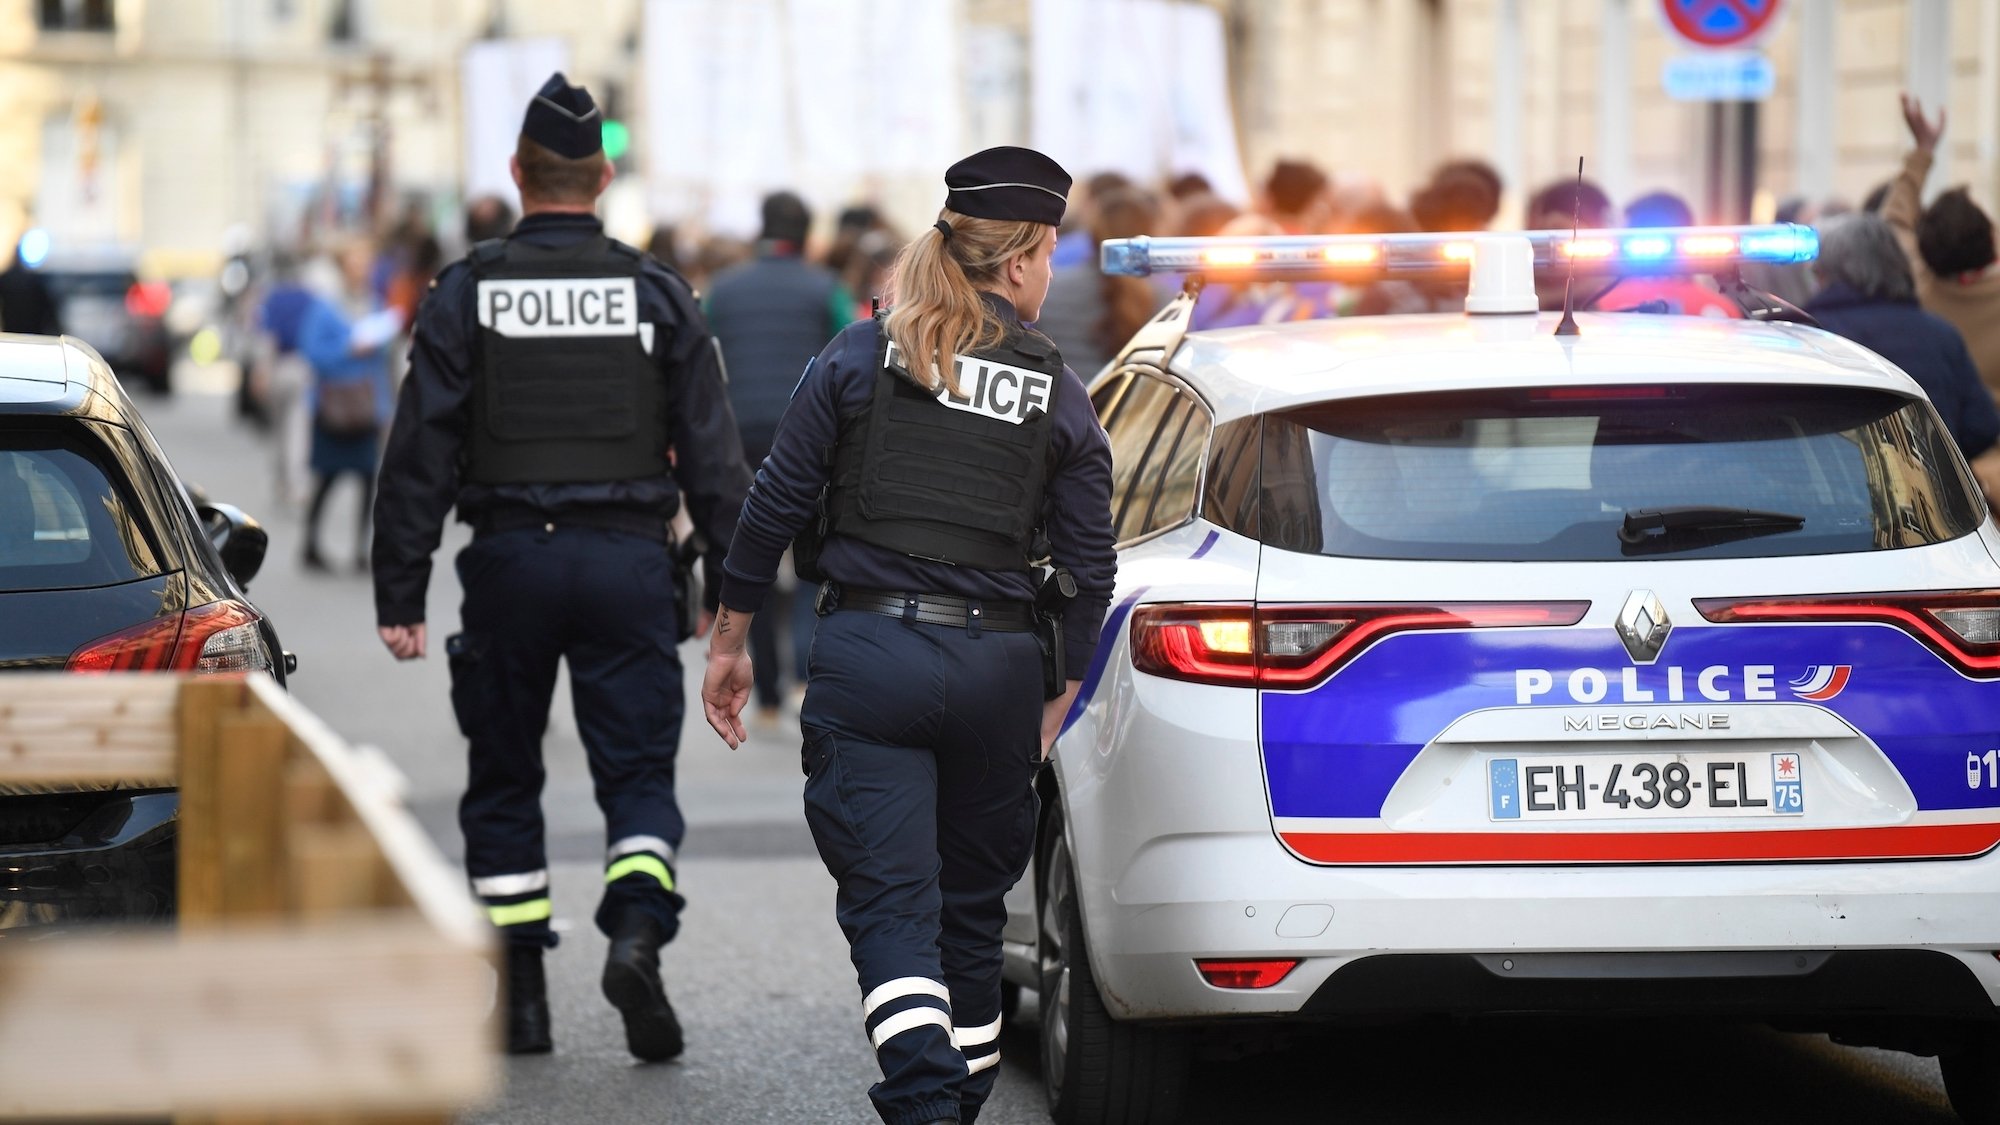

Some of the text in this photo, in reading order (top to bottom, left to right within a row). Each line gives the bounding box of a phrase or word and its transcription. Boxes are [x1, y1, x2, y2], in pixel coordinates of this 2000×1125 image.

[490, 289, 625, 328] POLICE
[890, 347, 1047, 419] LICE
[1515, 665, 1776, 704] POLICE
[1564, 713, 1730, 731] MEGANE
[1526, 763, 1767, 811] EH-438-EL
[1982, 750, 2000, 788] 1
[1501, 795, 1510, 809] F
[1776, 785, 1801, 807] 75
